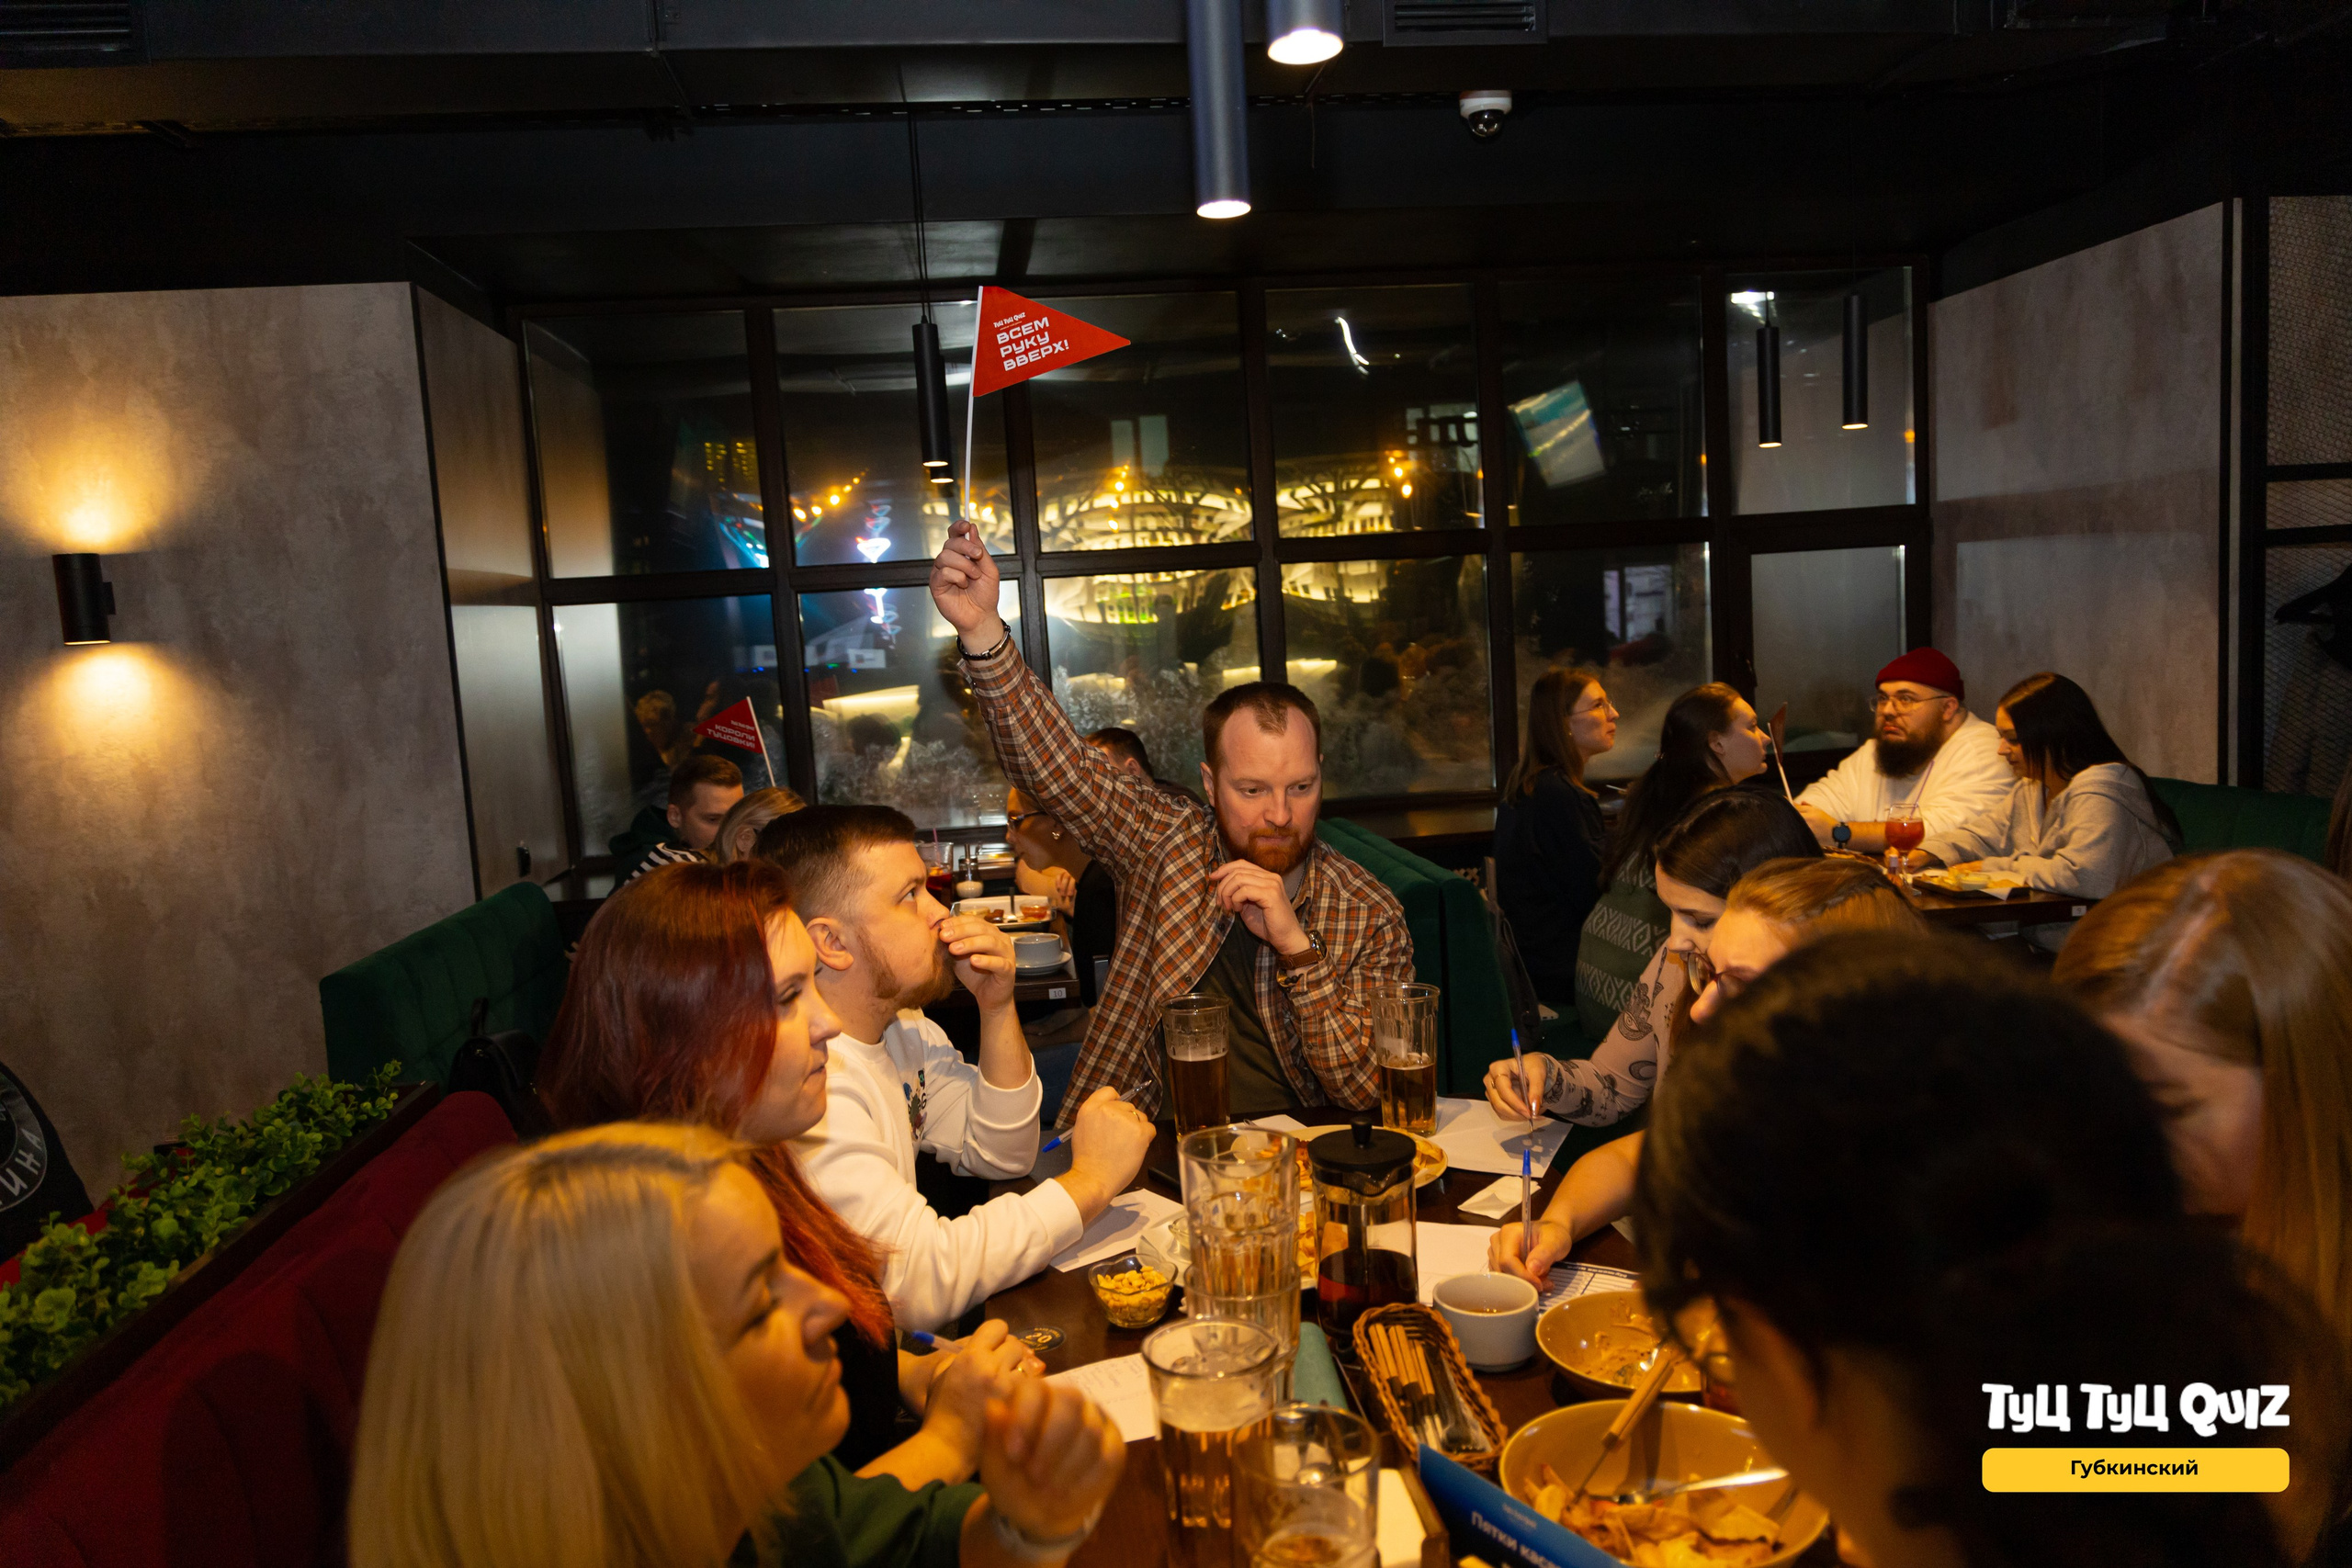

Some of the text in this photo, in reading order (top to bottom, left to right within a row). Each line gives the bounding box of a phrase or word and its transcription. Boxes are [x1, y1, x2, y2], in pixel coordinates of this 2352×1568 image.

[996, 317, 1050, 344] ВСЕМ
[1000, 332, 1050, 358] РУКУ
[1003, 339, 1069, 372] ВВЕРХ!
[715, 724, 755, 741] КОРОЛИ
[1053, 989, 1063, 998] 10
[0, 1127, 43, 1205] ИНА
